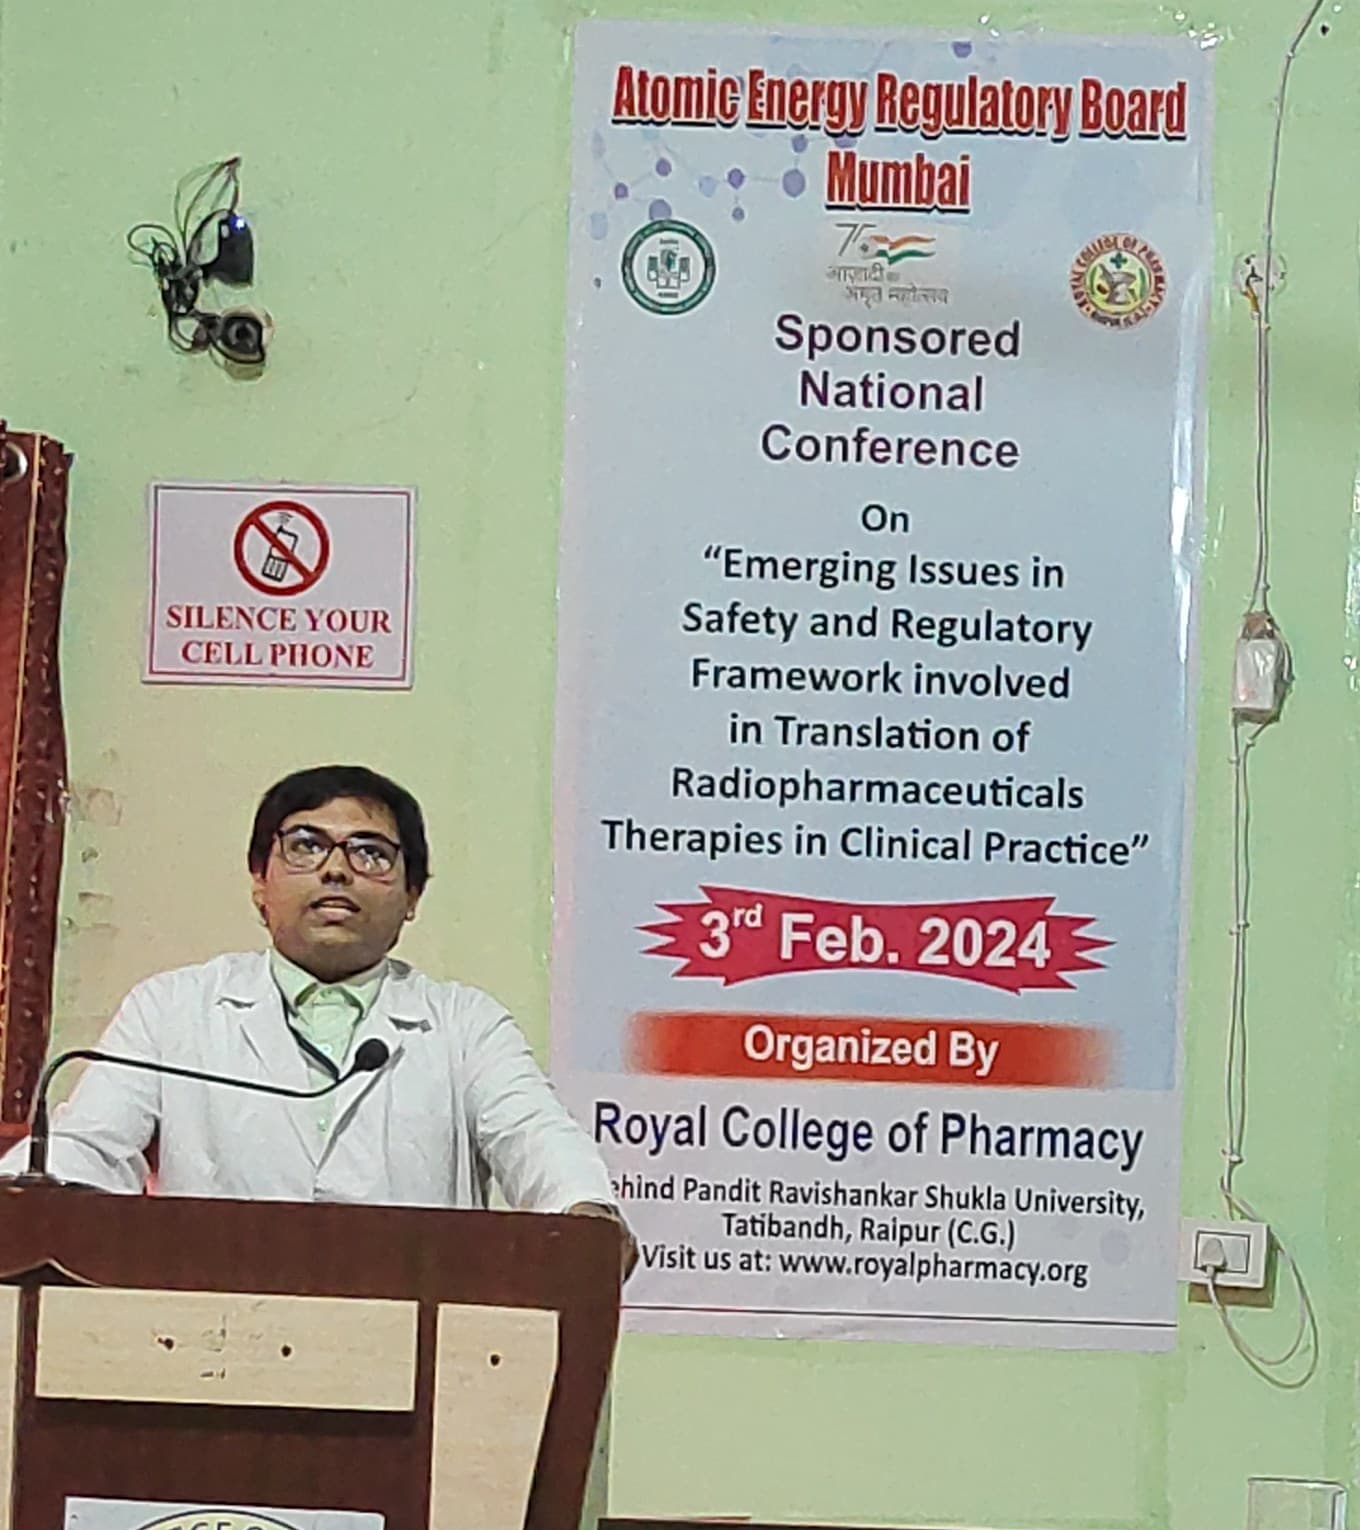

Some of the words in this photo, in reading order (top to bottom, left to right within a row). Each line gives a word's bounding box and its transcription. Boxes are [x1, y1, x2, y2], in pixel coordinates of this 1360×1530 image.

[613, 66, 740, 124] Atomic
[747, 69, 867, 130] Energy
[876, 73, 1072, 137] Regulatory
[1081, 78, 1187, 134] Board
[827, 151, 970, 208] Mumbai
[775, 314, 1019, 361] Sponsored
[800, 371, 983, 412] National
[761, 425, 1019, 468] Conference
[861, 504, 909, 533] On
[704, 545, 896, 590] “Emerging
[910, 555, 1019, 587] Issues
[1032, 555, 1063, 588] in
[166, 605, 297, 632] SILENCE
[304, 608, 391, 633] YOUR
[683, 604, 798, 642] Safety
[810, 608, 878, 638] and
[892, 608, 1091, 650] Regulatory
[181, 641, 262, 665] CELL
[270, 643, 373, 668] PHONE
[692, 658, 900, 695] Framework
[914, 662, 1070, 698] involved
[729, 713, 762, 744] in
[775, 716, 979, 752] Translation
[993, 720, 1032, 752] of
[671, 768, 1084, 809] Radiopharmaceuticals
[602, 820, 783, 860] Therapies
[796, 826, 826, 856] in
[841, 828, 970, 861] Clinical
[985, 831, 1149, 866] Practice”
[781, 914, 898, 963] Feb.
[918, 919, 1051, 968] 2024
[744, 1025, 937, 1070] Organized
[949, 1033, 1000, 1075] By
[595, 1101, 707, 1156] Royal
[723, 1107, 873, 1161] College
[889, 1112, 928, 1150] of
[942, 1113, 1143, 1170] Pharmacy
[610, 1174, 674, 1199] ehind
[684, 1178, 760, 1202] Pandit
[769, 1180, 918, 1209] Ravishankar
[925, 1184, 1007, 1212] Shukla
[1015, 1188, 1145, 1220] University,
[722, 1213, 852, 1244] Tatibandh,
[860, 1220, 940, 1248] Raipur
[948, 1220, 1016, 1250] (C.G.)
[642, 1244, 696, 1269] Visit
[705, 1252, 731, 1270] us
[739, 1250, 771, 1271] at:
[780, 1258, 1087, 1288] www.royalpharmacy.org
